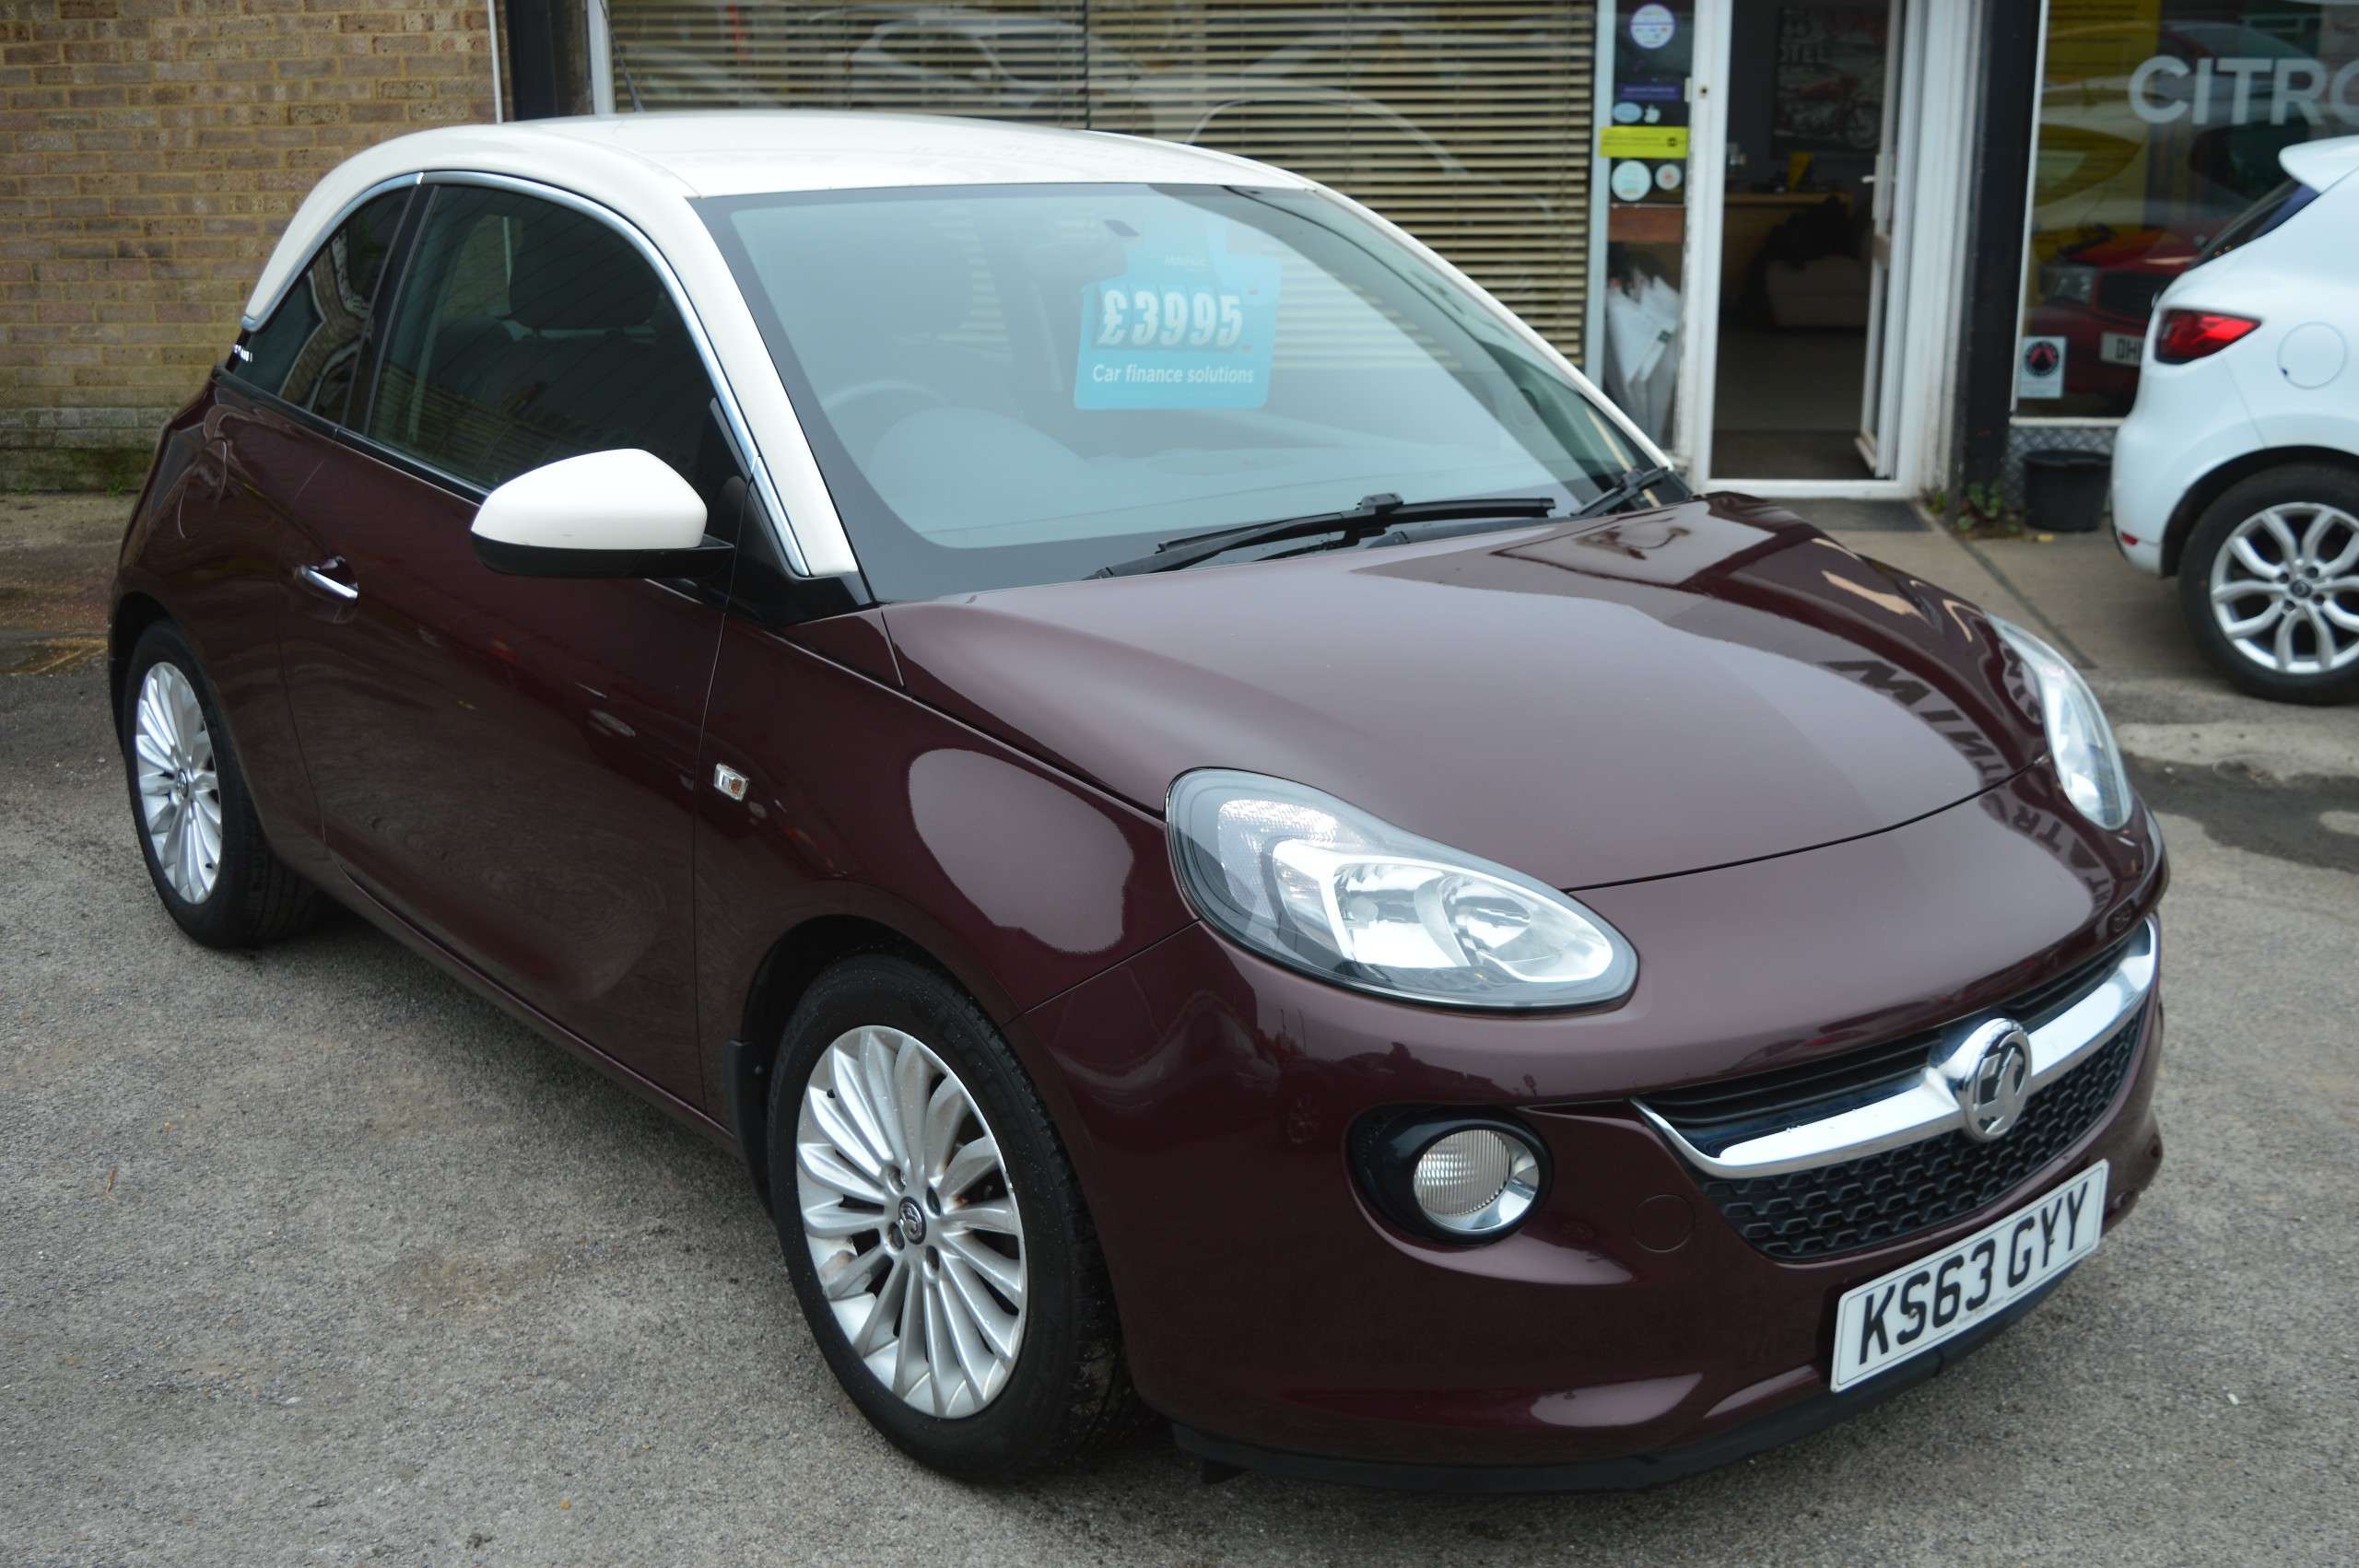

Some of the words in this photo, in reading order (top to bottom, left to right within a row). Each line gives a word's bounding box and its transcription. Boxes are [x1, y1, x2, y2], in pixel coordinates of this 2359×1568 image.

[1096, 289, 1244, 347] £3995
[1092, 364, 1121, 383] Car
[1125, 363, 1183, 383] finance
[1187, 365, 1255, 384] solutions
[1858, 1238, 1996, 1366] KS63
[2006, 1181, 2089, 1290] GYY
